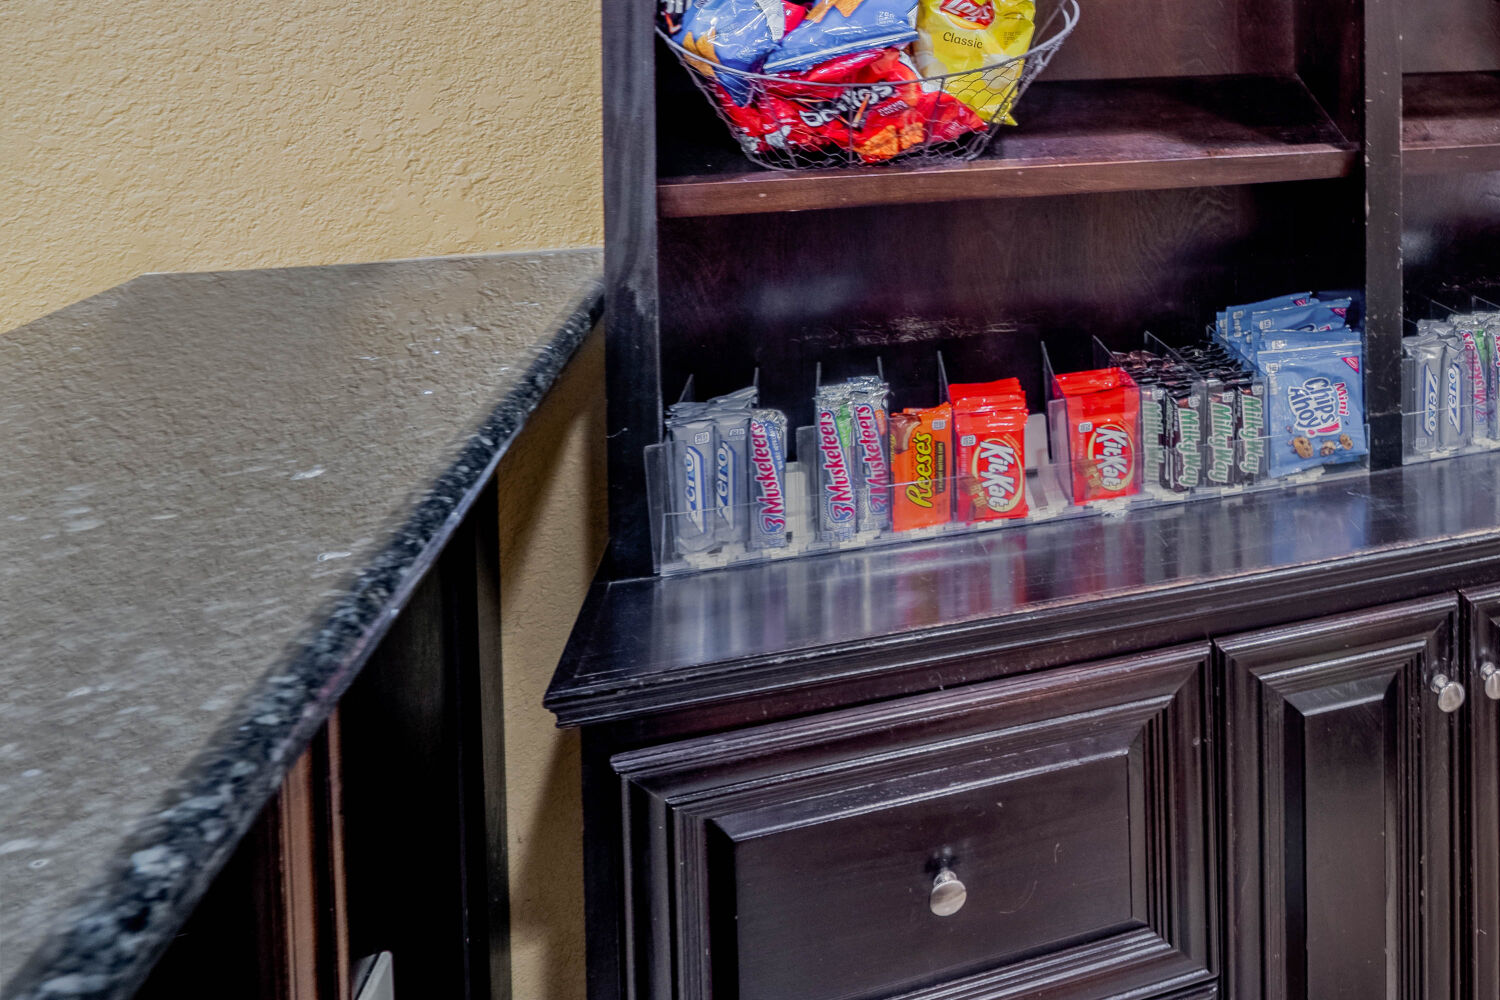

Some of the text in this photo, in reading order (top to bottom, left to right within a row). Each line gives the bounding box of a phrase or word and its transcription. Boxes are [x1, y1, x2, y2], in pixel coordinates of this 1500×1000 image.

[943, 31, 984, 50] Classic
[1239, 394, 1264, 474] Milky Way
[1334, 382, 1349, 416] Mini
[751, 422, 784, 516] Musketeers
[818, 411, 855, 522] 3 Musketeers
[855, 404, 889, 495] Musketeers
[905, 431, 933, 508] Reese's
[1177, 408, 1200, 487] Milky Way
[1207, 402, 1233, 483] Milky Way
[765, 515, 786, 532] 3
